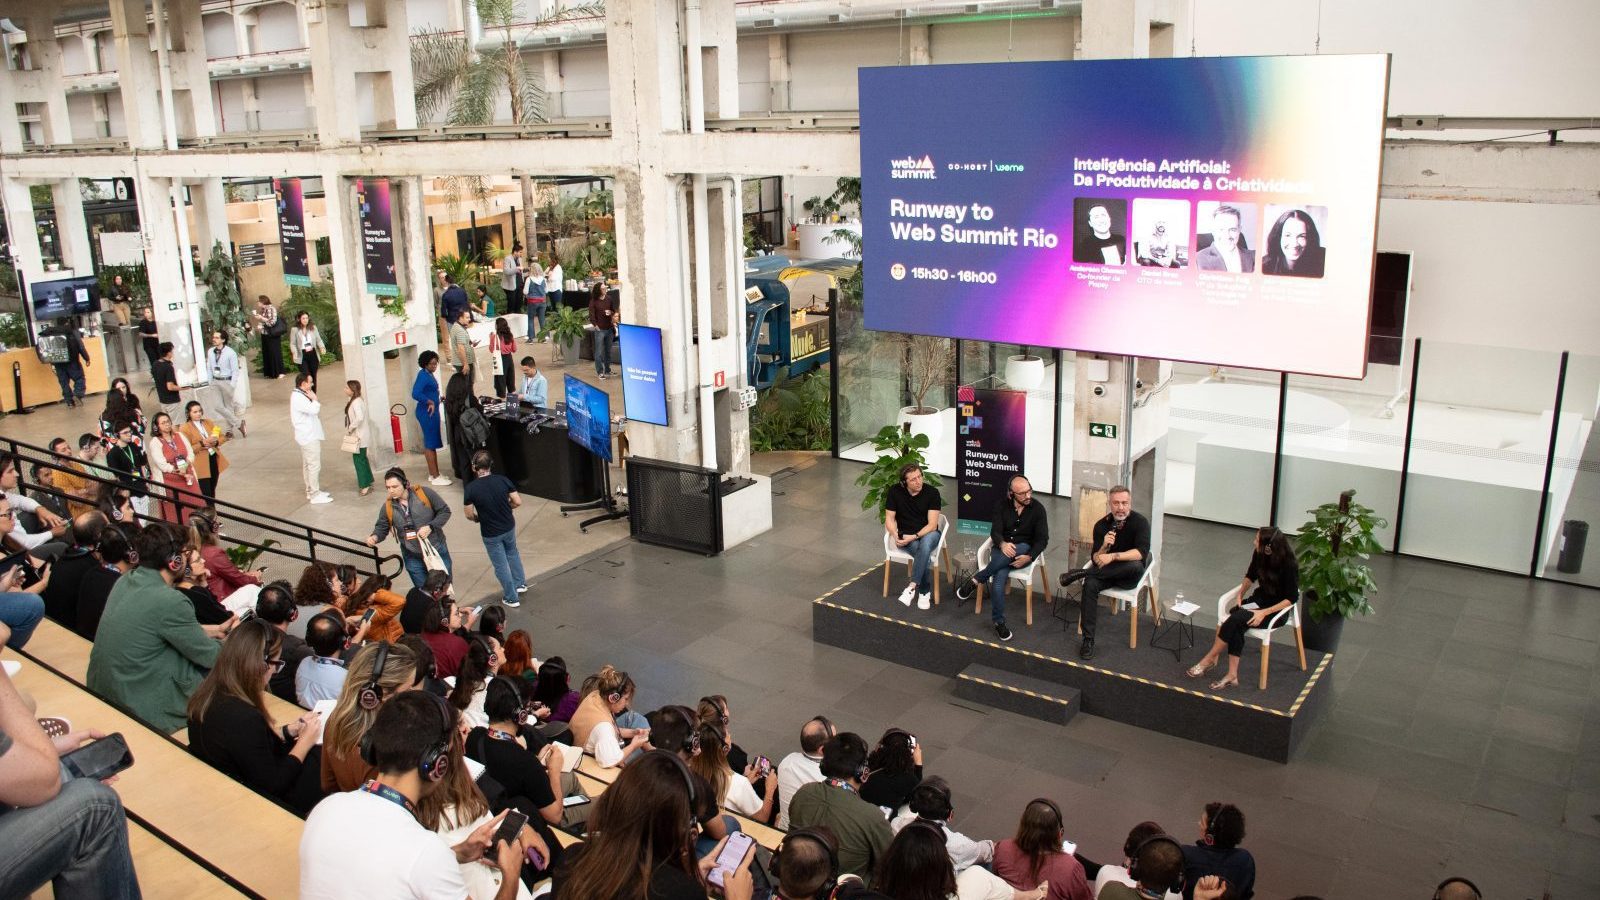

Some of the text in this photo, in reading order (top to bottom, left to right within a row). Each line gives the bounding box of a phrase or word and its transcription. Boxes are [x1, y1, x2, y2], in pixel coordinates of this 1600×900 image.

[891, 156, 915, 169] web
[1074, 157, 1231, 174] Inteligência Artificial:
[1073, 173, 1093, 186] Da
[1096, 174, 1200, 190] Produtividade
[1202, 177, 1213, 190] à
[890, 198, 994, 223] Runway to
[890, 221, 1058, 248] Web Summit Rio
[911, 268, 948, 280] 15h30
[957, 270, 997, 284] 16h00
[965, 450, 1009, 462] Runway to
[965, 460, 1019, 472] Web Summit
[965, 469, 980, 477] Rio
